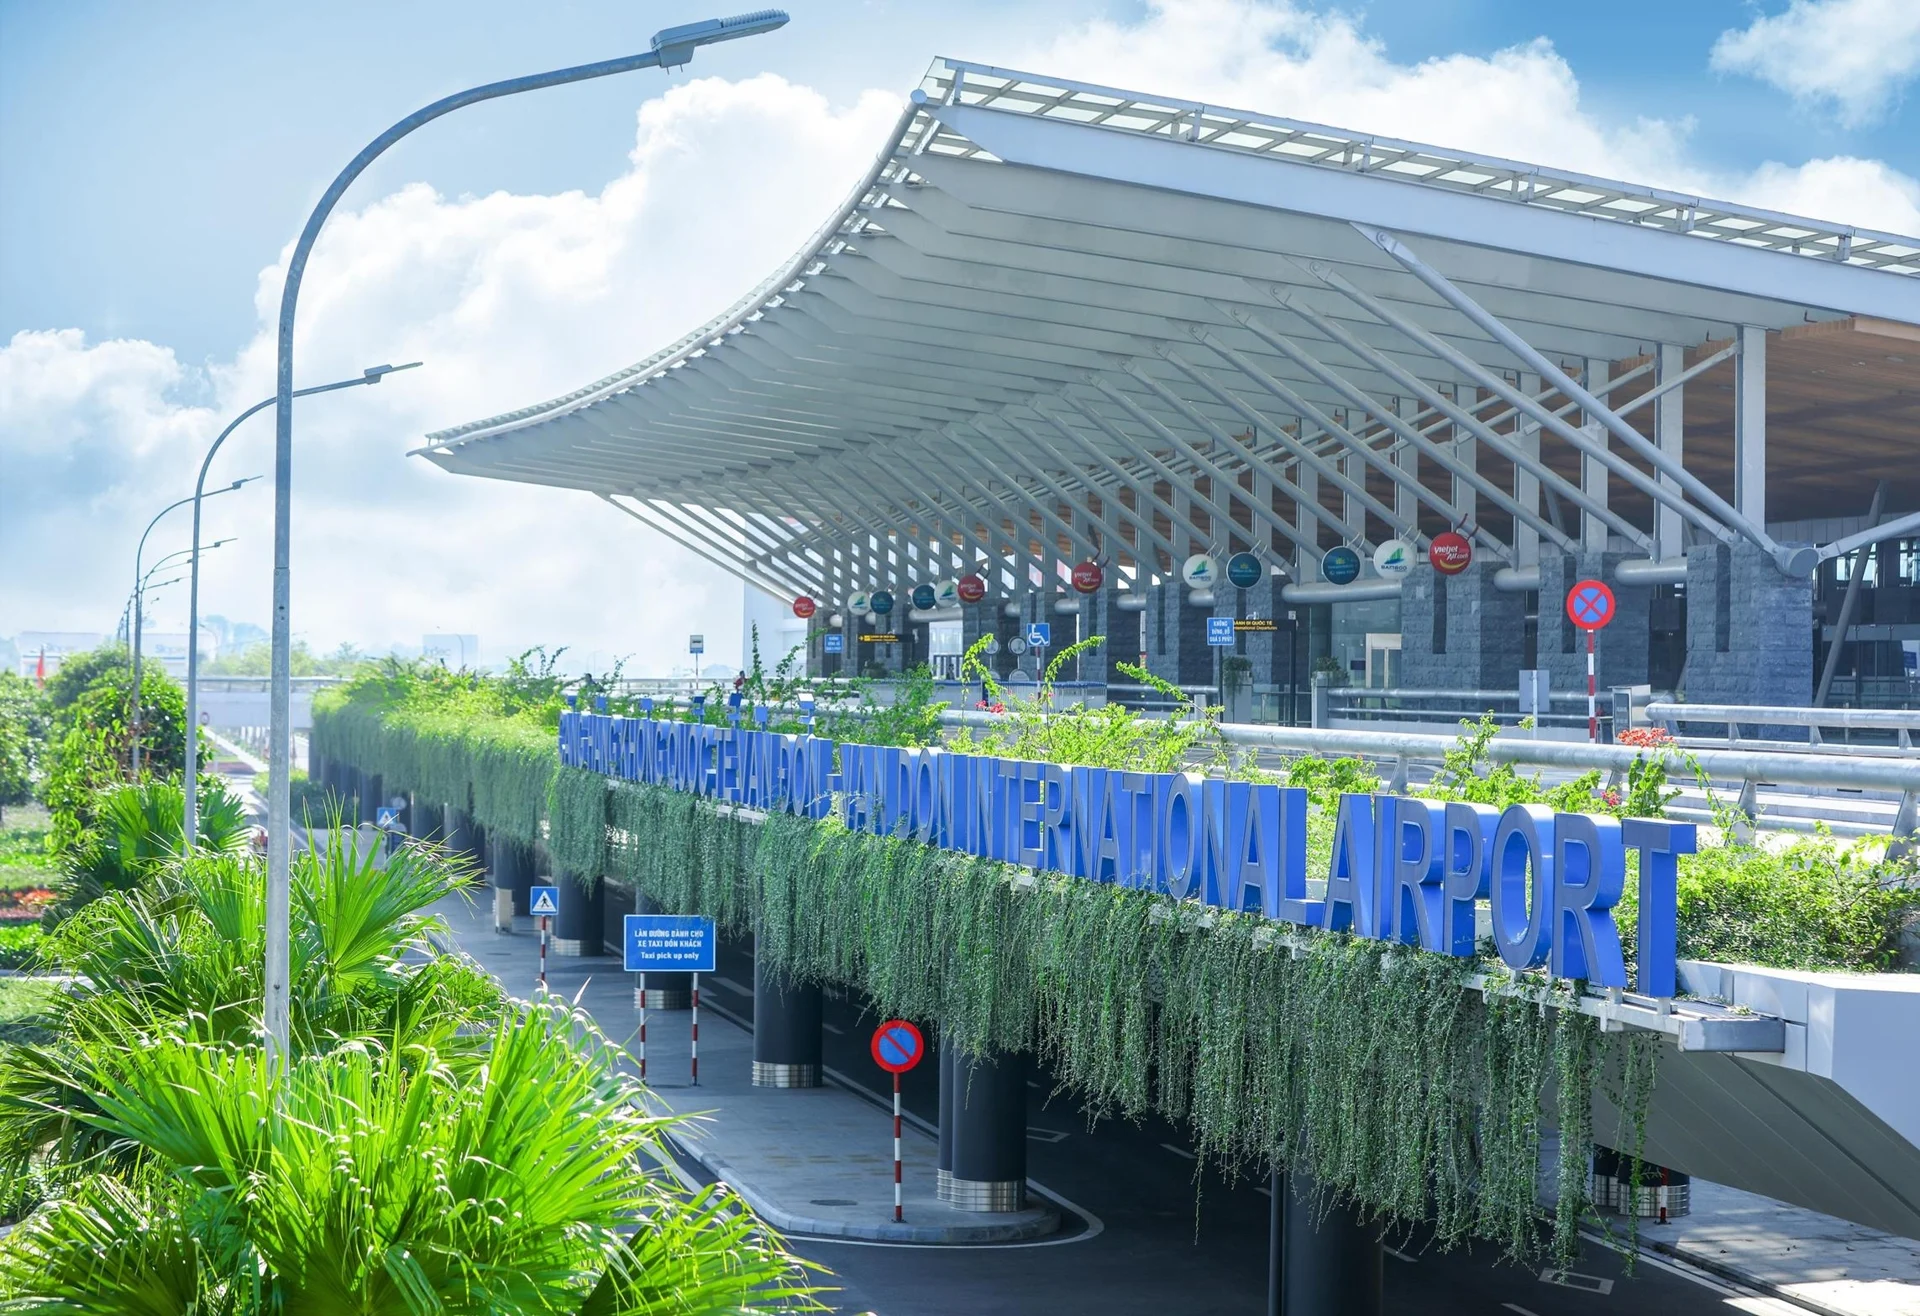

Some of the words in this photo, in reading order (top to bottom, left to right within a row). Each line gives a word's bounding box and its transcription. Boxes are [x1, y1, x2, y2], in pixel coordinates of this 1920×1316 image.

[840, 743, 897, 837] VAN
[897, 747, 966, 852] DON
[966, 755, 1307, 926] INTERNATIONAL
[1322, 793, 1697, 998] AIRPORT
[634, 928, 647, 937] LÀN
[679, 939, 702, 947] KHÁCH
[656, 952, 672, 960] pick
[683, 952, 699, 960] only
